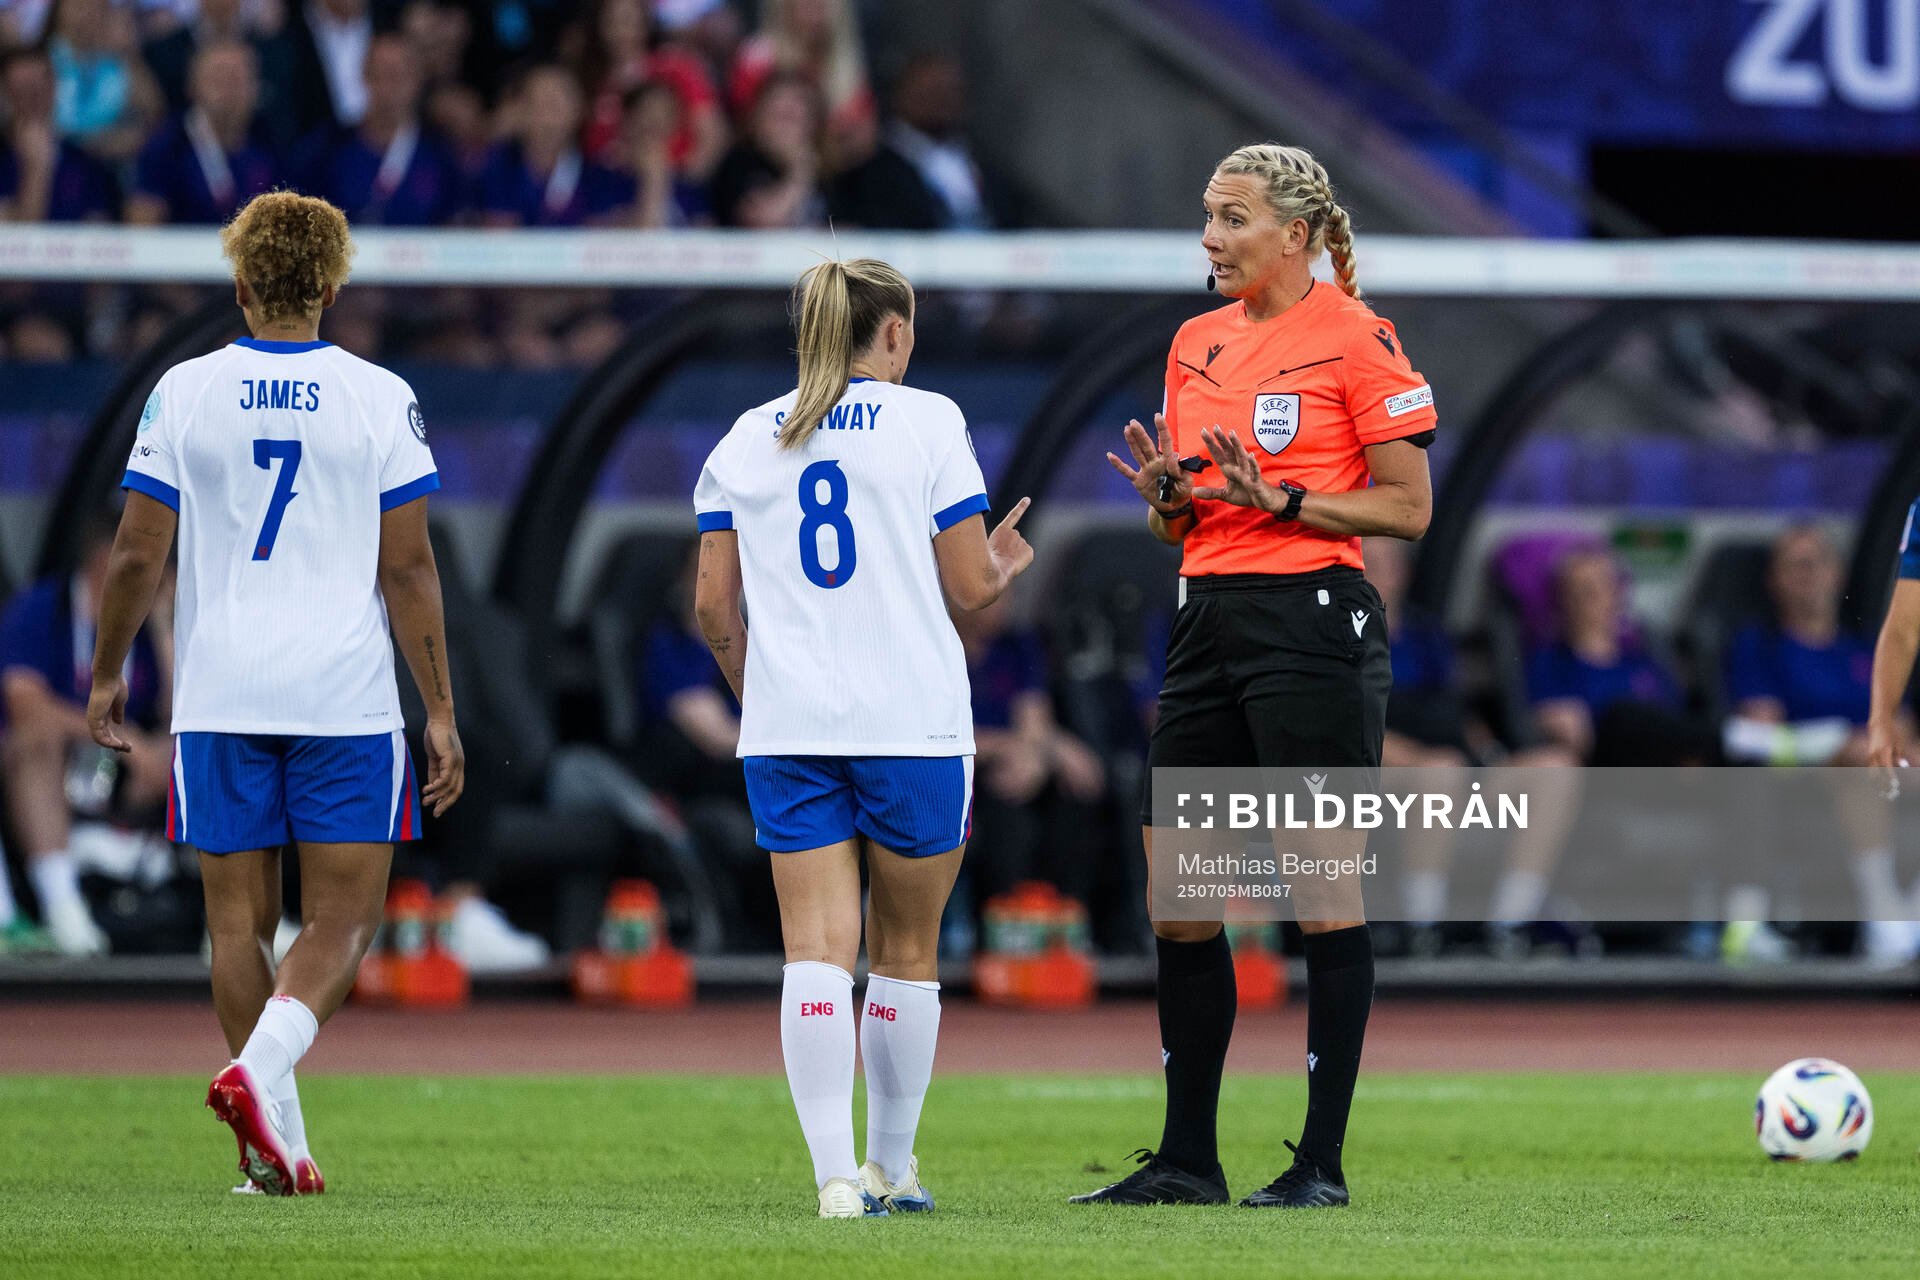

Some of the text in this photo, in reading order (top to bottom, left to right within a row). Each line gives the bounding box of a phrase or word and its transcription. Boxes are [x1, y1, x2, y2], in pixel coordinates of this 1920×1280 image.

[239, 379, 320, 412] JAMES
[1262, 400, 1288, 412] UEFA
[1387, 391, 1432, 411] FOUNDATIO
[773, 402, 882, 439] SWAY
[251, 438, 302, 561] 7
[799, 459, 857, 589] 8
[801, 1002, 834, 1017] ENG
[868, 1002, 897, 1022] ENG
